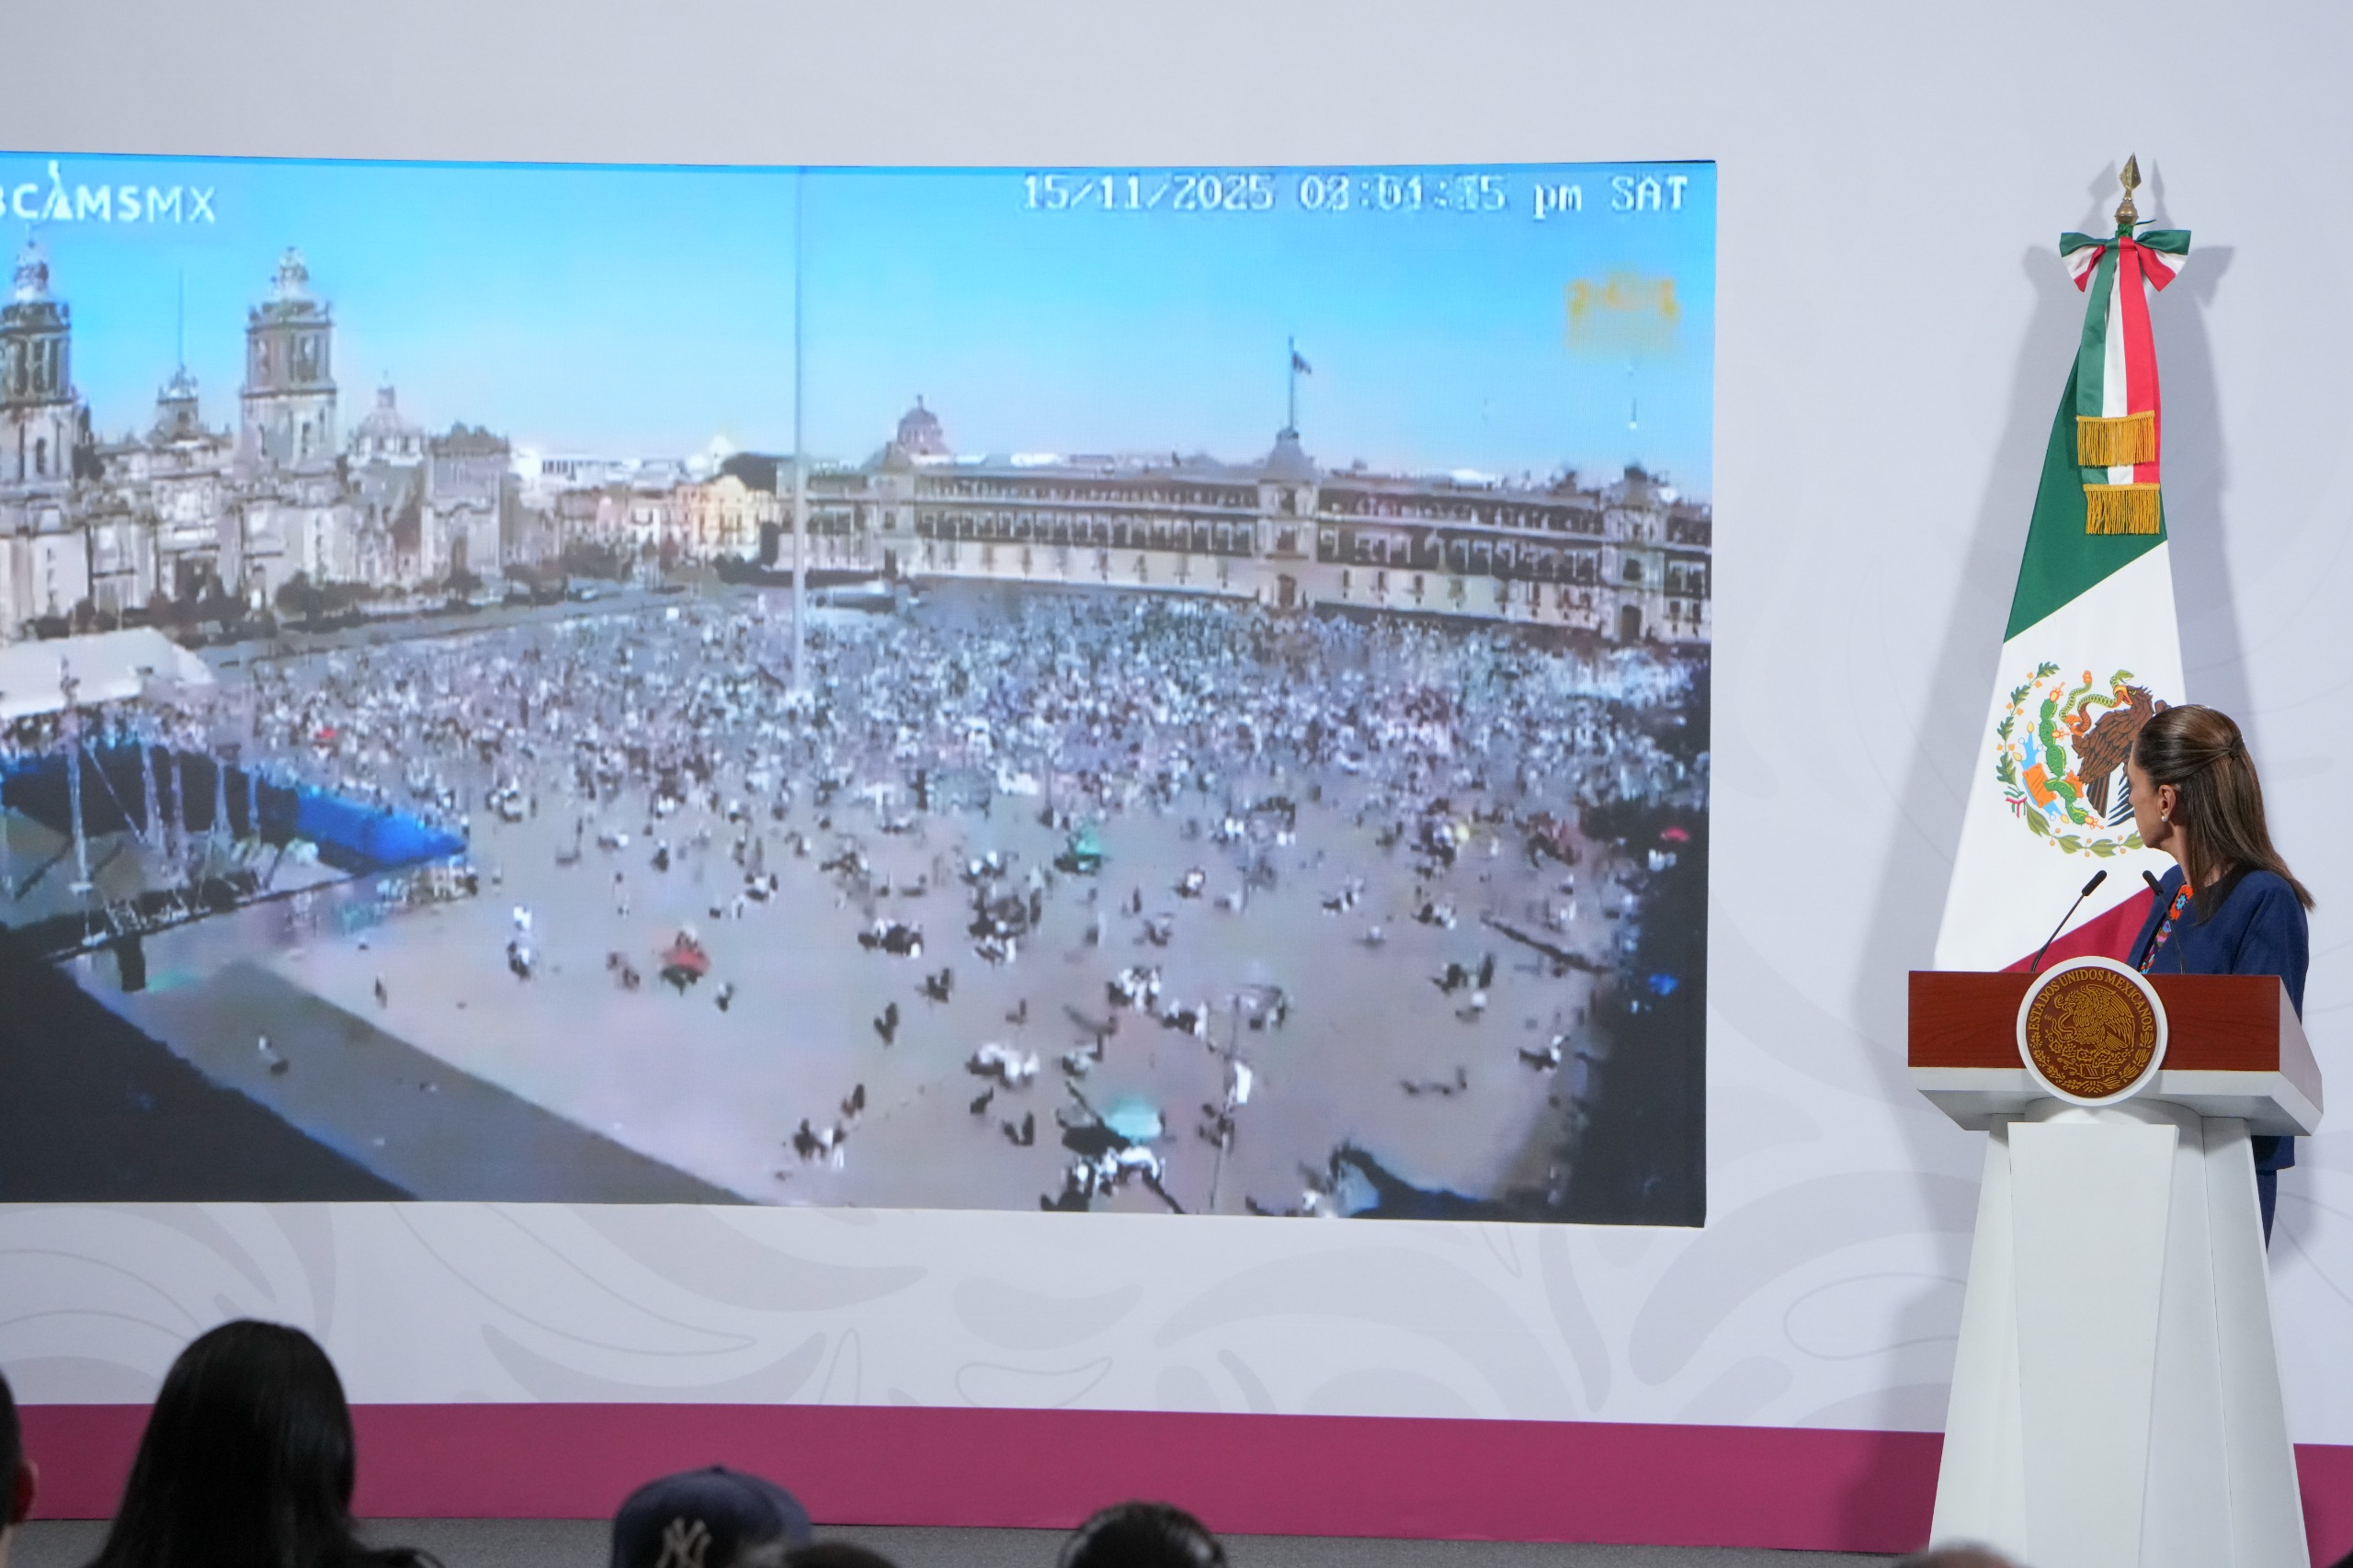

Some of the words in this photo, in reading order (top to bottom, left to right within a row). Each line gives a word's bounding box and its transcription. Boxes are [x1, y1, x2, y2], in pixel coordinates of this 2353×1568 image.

[1023, 174, 1274, 210] 15/11/2025
[1532, 182, 1582, 220] pm
[1612, 176, 1688, 211] SAT
[2029, 980, 2061, 1031] ESTADOS
[2059, 969, 2105, 987] UNIDOS
[2106, 971, 2154, 1032] MEXICANOS
